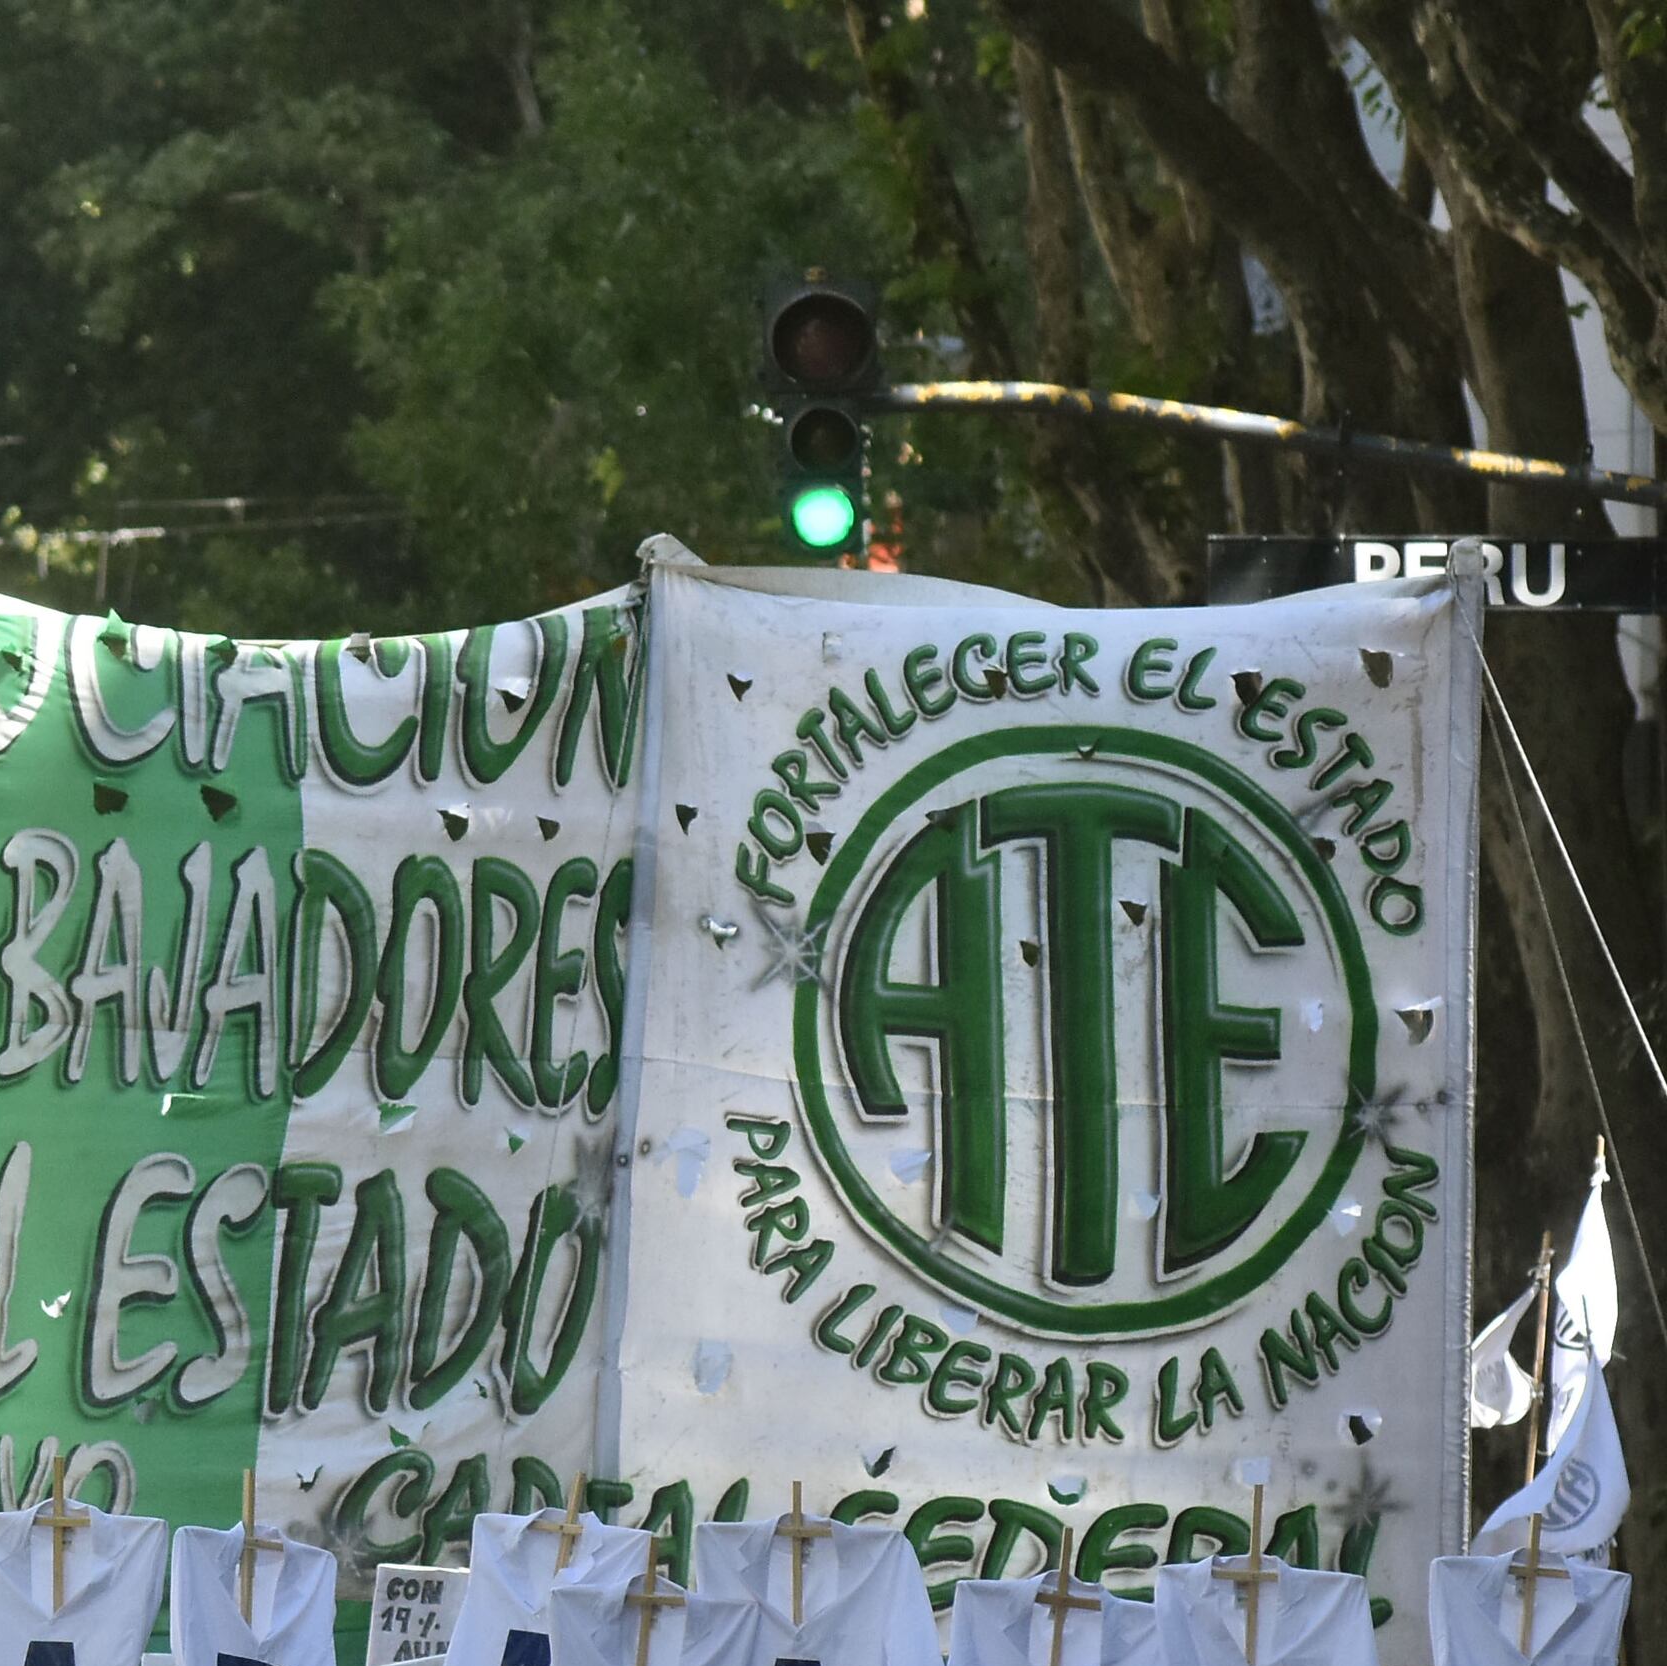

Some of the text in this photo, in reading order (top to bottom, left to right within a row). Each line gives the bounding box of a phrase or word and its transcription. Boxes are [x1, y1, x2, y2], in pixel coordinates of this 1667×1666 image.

[734, 630, 1427, 938] FORTALECER EL ESTADO
[840, 780, 1309, 1287] ATE
[79, 1151, 607, 1420] ESTADO
[725, 1112, 1442, 1447] PARA LIBERAR LA NACION
[386, 1577, 443, 1605] CON
